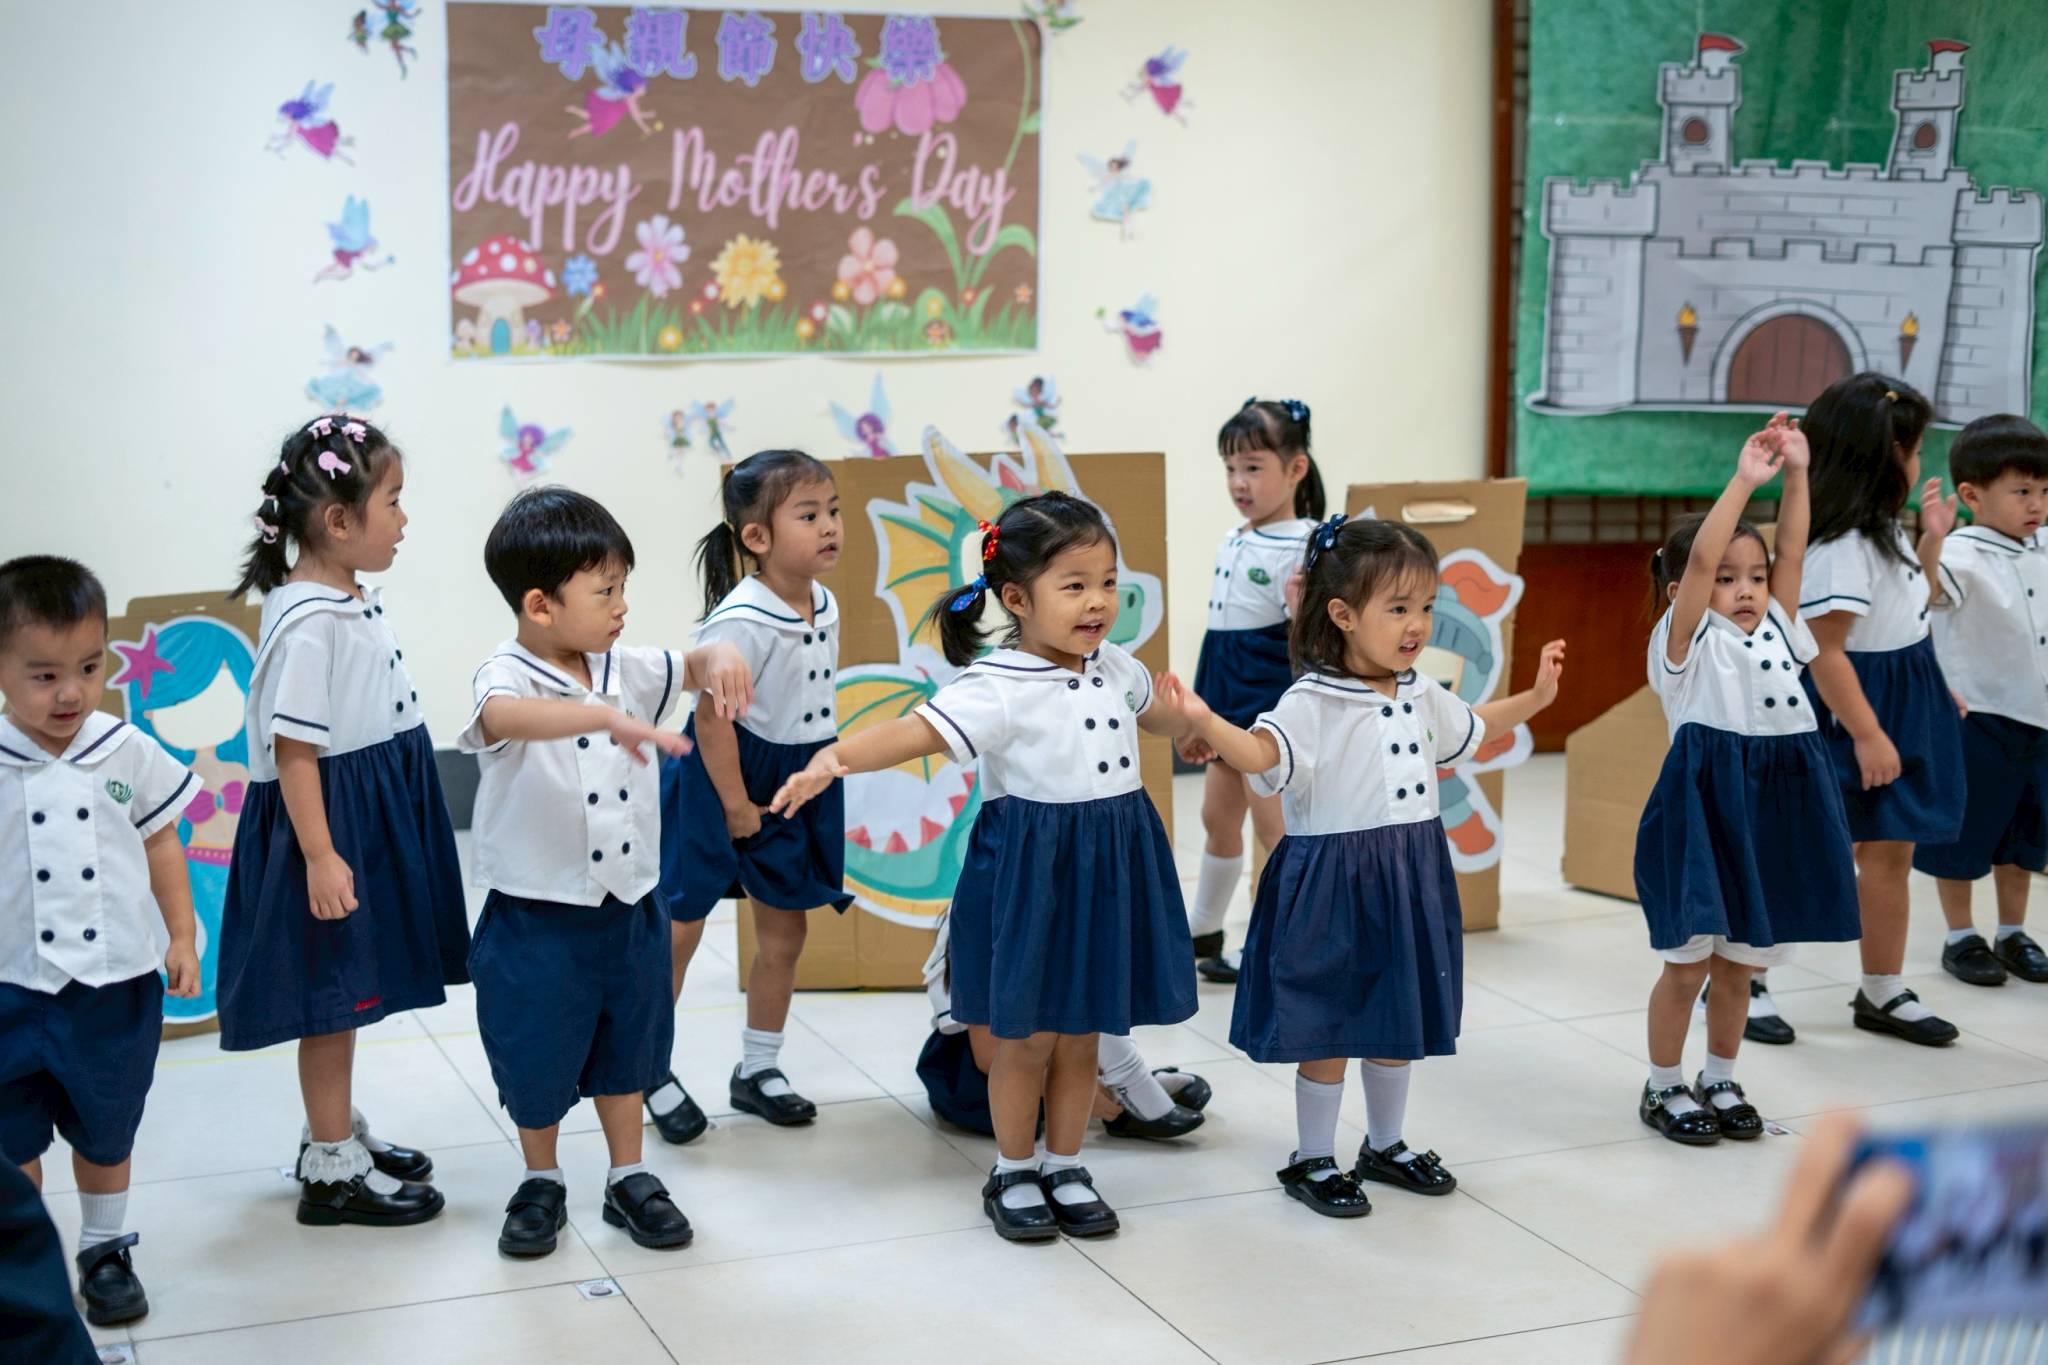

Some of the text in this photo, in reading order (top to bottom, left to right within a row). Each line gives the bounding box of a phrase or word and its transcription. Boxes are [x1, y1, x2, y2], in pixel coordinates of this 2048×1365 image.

[534, 5, 942, 86] 母親節快樂
[454, 122, 1017, 256] Happy Mother's Day
